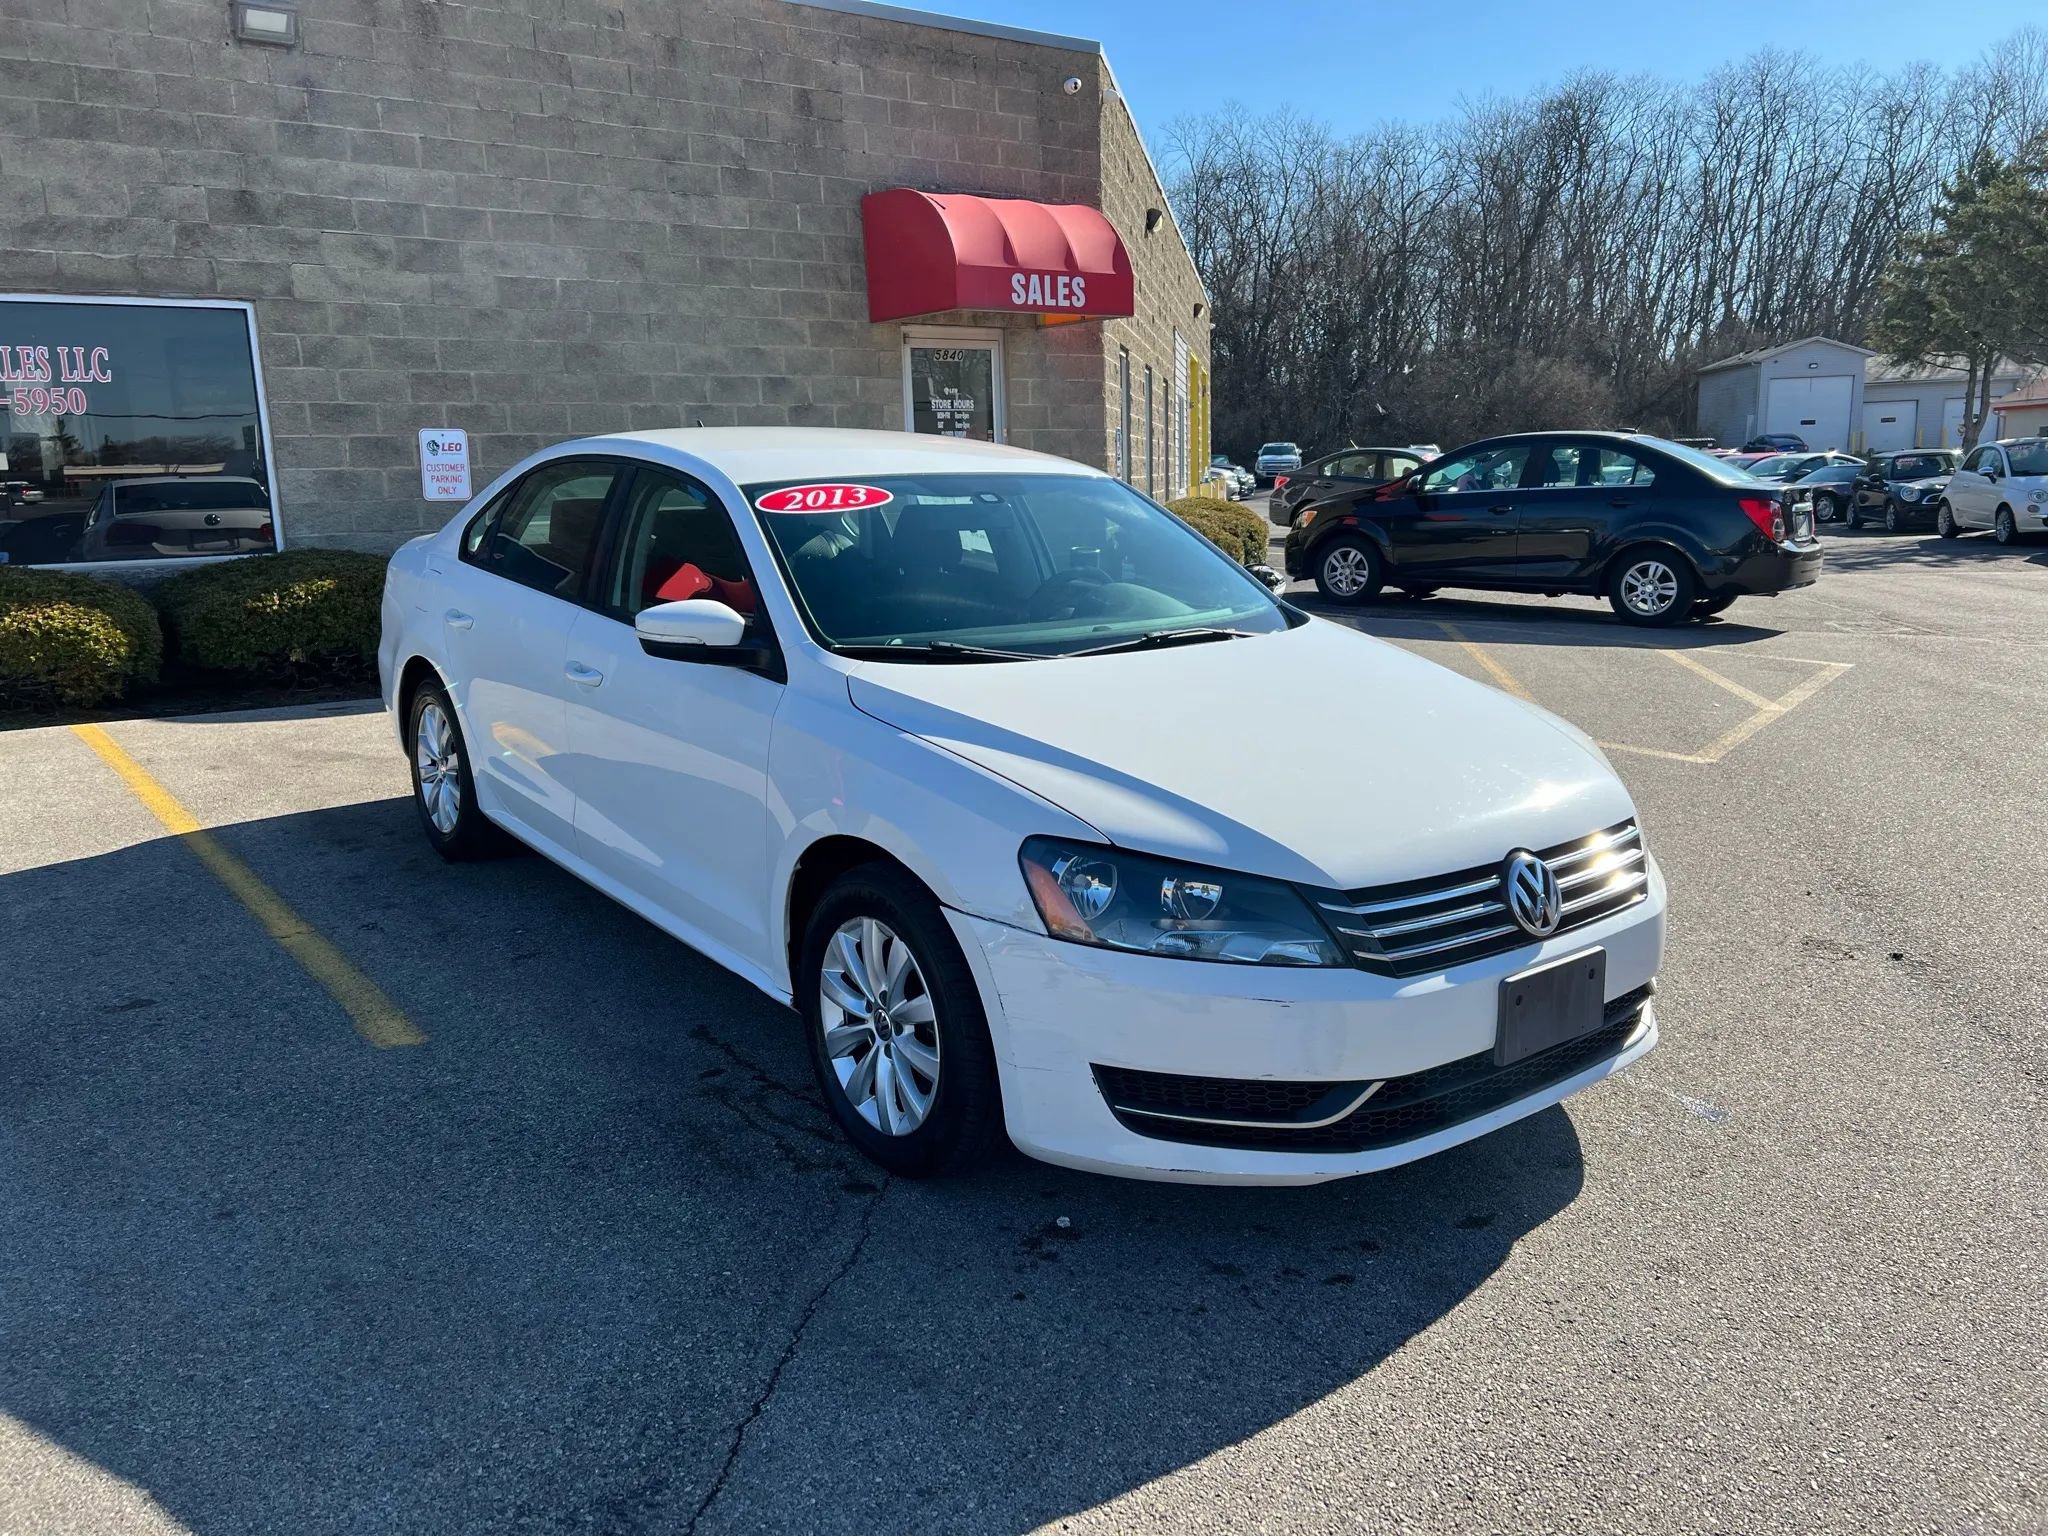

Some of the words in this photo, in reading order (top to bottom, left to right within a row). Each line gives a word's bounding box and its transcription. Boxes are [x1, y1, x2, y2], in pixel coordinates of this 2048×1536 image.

[1011, 273, 1086, 307] SALES
[934, 349, 964, 361] 5840
[0, 346, 52, 382] LES
[57, 347, 112, 382] LLC
[931, 400, 952, 409] STORE
[953, 400, 975, 409] HOURS
[441, 443, 462, 452] LEO
[426, 463, 465, 472] CUSTOMER
[431, 475, 463, 483] PARKING
[438, 486, 457, 494] ONLY
[783, 488, 867, 510] 2013
